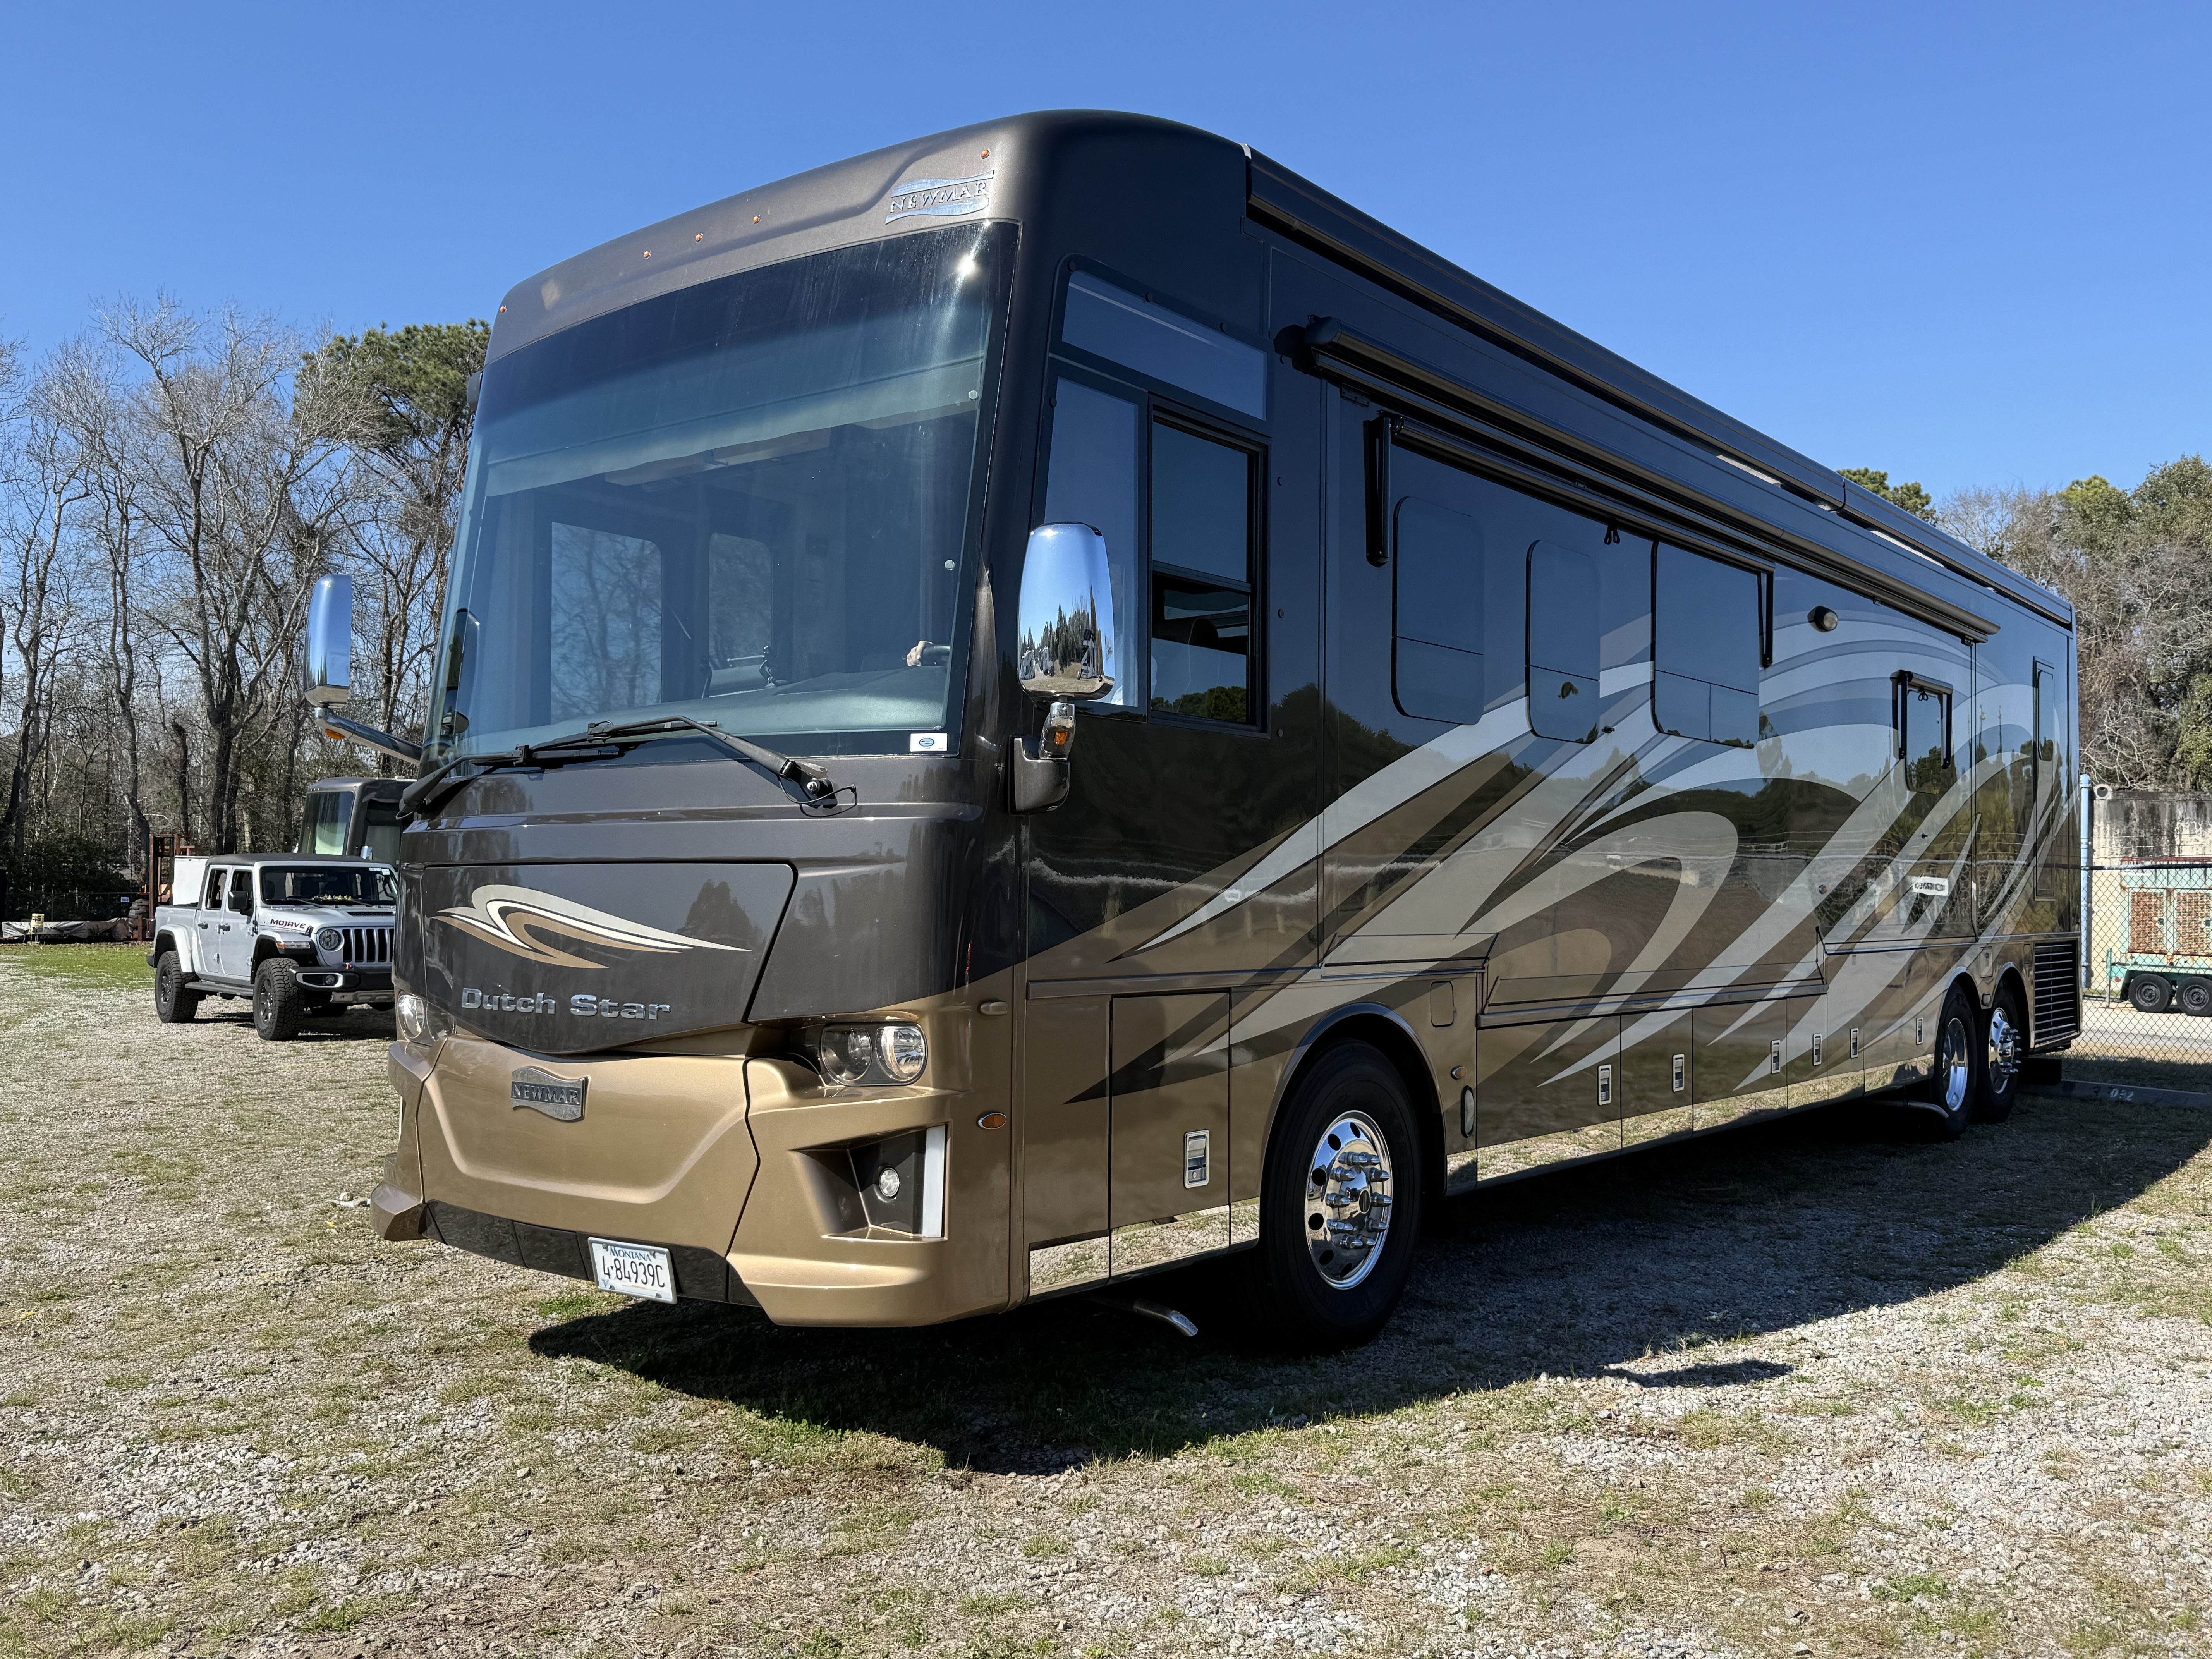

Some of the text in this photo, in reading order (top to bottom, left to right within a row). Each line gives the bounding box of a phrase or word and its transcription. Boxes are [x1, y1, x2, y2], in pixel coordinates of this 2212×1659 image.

[890, 182, 992, 213] NEWMAR
[270, 919, 306, 929] MOJAVE
[461, 988, 671, 1020] Dutch Star
[512, 1084, 579, 1104] NEWMAR
[610, 1246, 652, 1262] MONTANA
